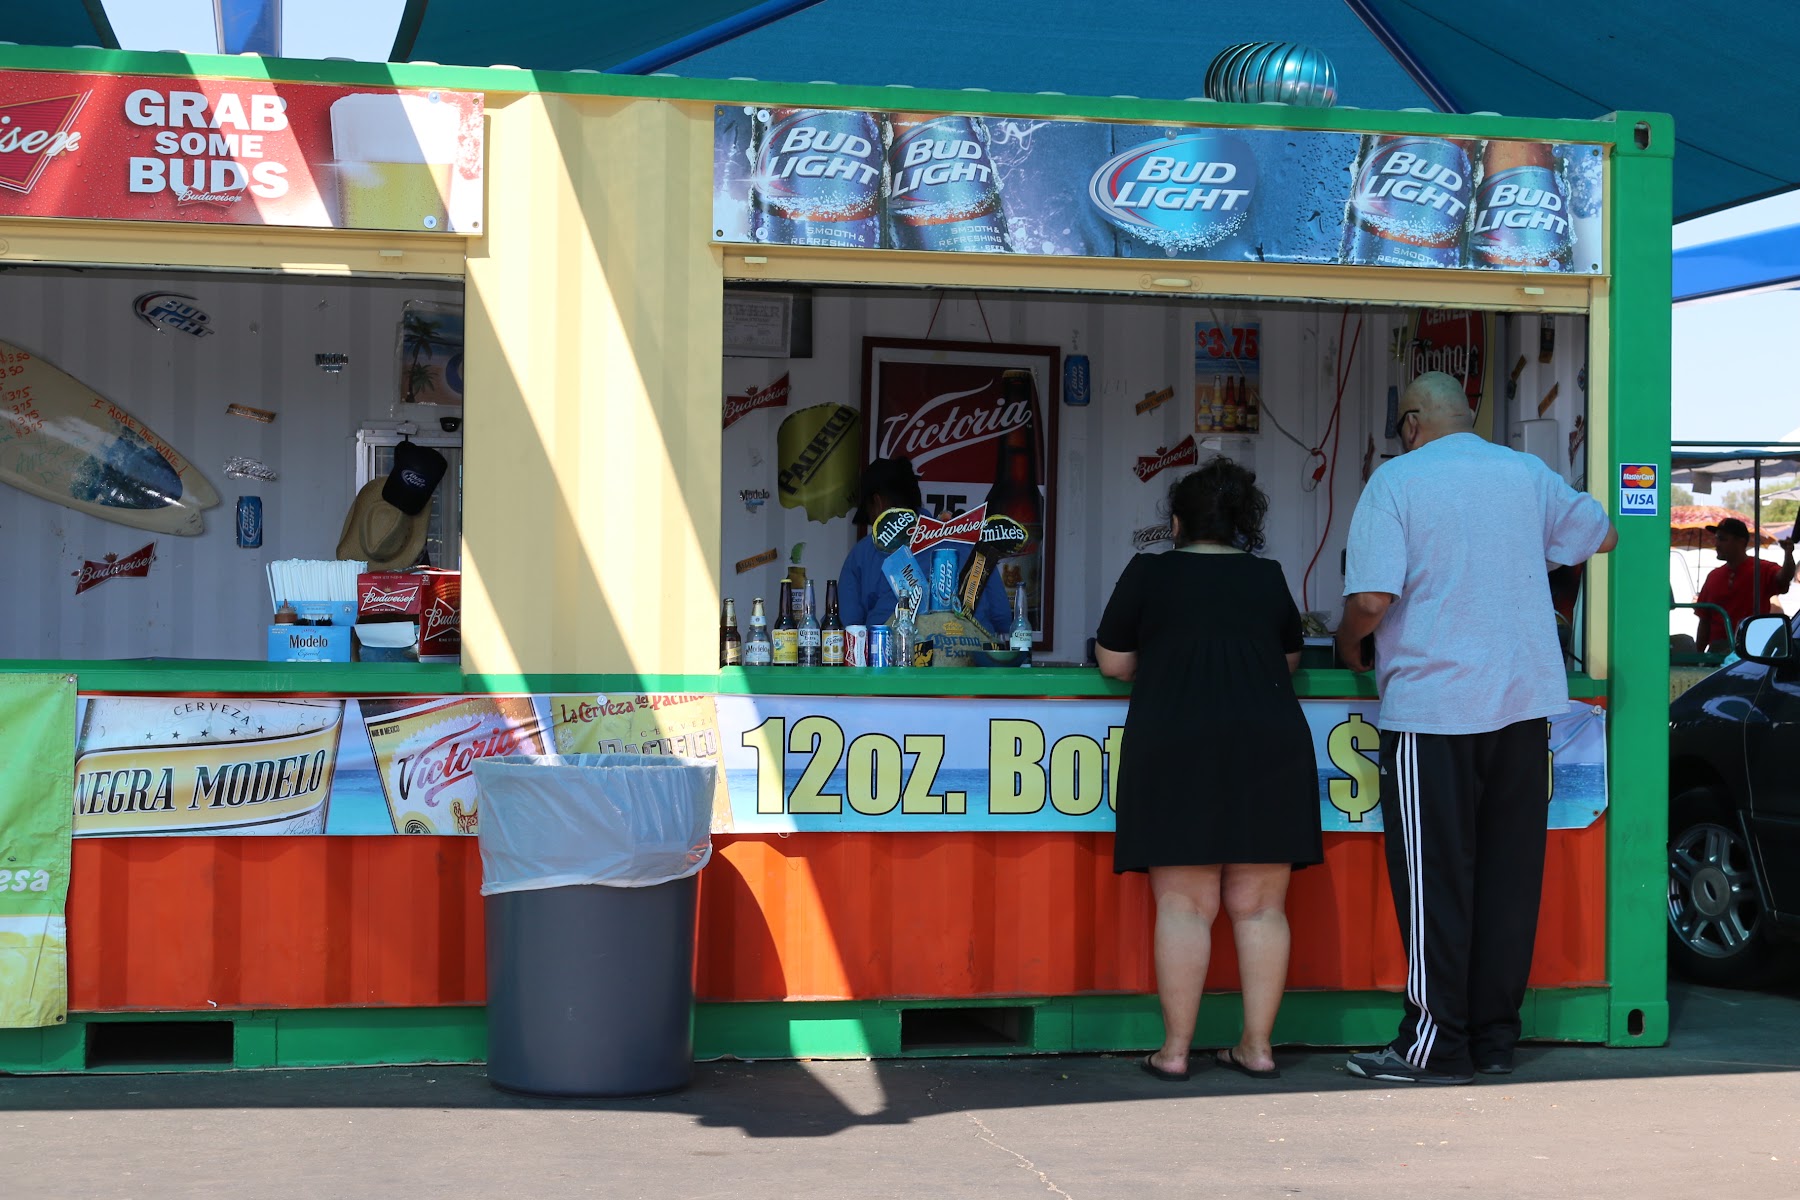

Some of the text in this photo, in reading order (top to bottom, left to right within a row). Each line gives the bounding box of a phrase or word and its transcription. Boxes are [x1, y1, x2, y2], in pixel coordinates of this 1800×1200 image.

[125, 89, 289, 132] GRAB
[155, 131, 264, 158] SOME
[780, 126, 872, 159] BUD
[903, 138, 982, 168] BUD
[130, 157, 289, 199] BUDS
[765, 155, 879, 185] LIGHT
[891, 162, 992, 198] LIGHT
[1137, 156, 1237, 184] BUD
[1381, 151, 1463, 192] BUD
[175, 188, 242, 204] Budweiser
[1113, 182, 1250, 211] LIGHT
[1361, 175, 1466, 217] LIGHT
[1489, 184, 1562, 212] BUD
[806, 226, 865, 243] SMOOTH &
[951, 226, 993, 235] SMOOTH
[1475, 208, 1568, 234] LIGHT
[938, 235, 1002, 246] REFRESHING
[142, 306, 214, 337] LIGHT
[163, 300, 210, 325] BUD
[1198, 328, 1258, 359] $3.75
[316, 354, 348, 366] Modelo
[723, 384, 791, 418] Budweiser
[879, 378, 1032, 462] Victoria
[778, 406, 854, 495] PACIFICO
[1135, 446, 1197, 478] Budweiser
[1623, 473, 1655, 481] MasterCard
[740, 489, 770, 501] Modelo
[1625, 494, 1654, 505] VISA
[878, 512, 914, 547] mike's
[906, 518, 988, 545] Budweiser
[982, 524, 1025, 542] mike's
[76, 552, 156, 584] Budweiser
[938, 563, 946, 592] BUD
[945, 560, 953, 599] LIGHT
[362, 591, 415, 604] Budweiser
[289, 634, 328, 648] Modelo
[926, 633, 981, 651] Corona
[945, 647, 969, 658] Extr
[173, 702, 250, 726] CERVEZA
[384, 725, 400, 735] MEXICO
[398, 721, 521, 803] Victoria
[742, 716, 966, 815] 12oz.
[73, 749, 326, 816] NEGRA MODELO
